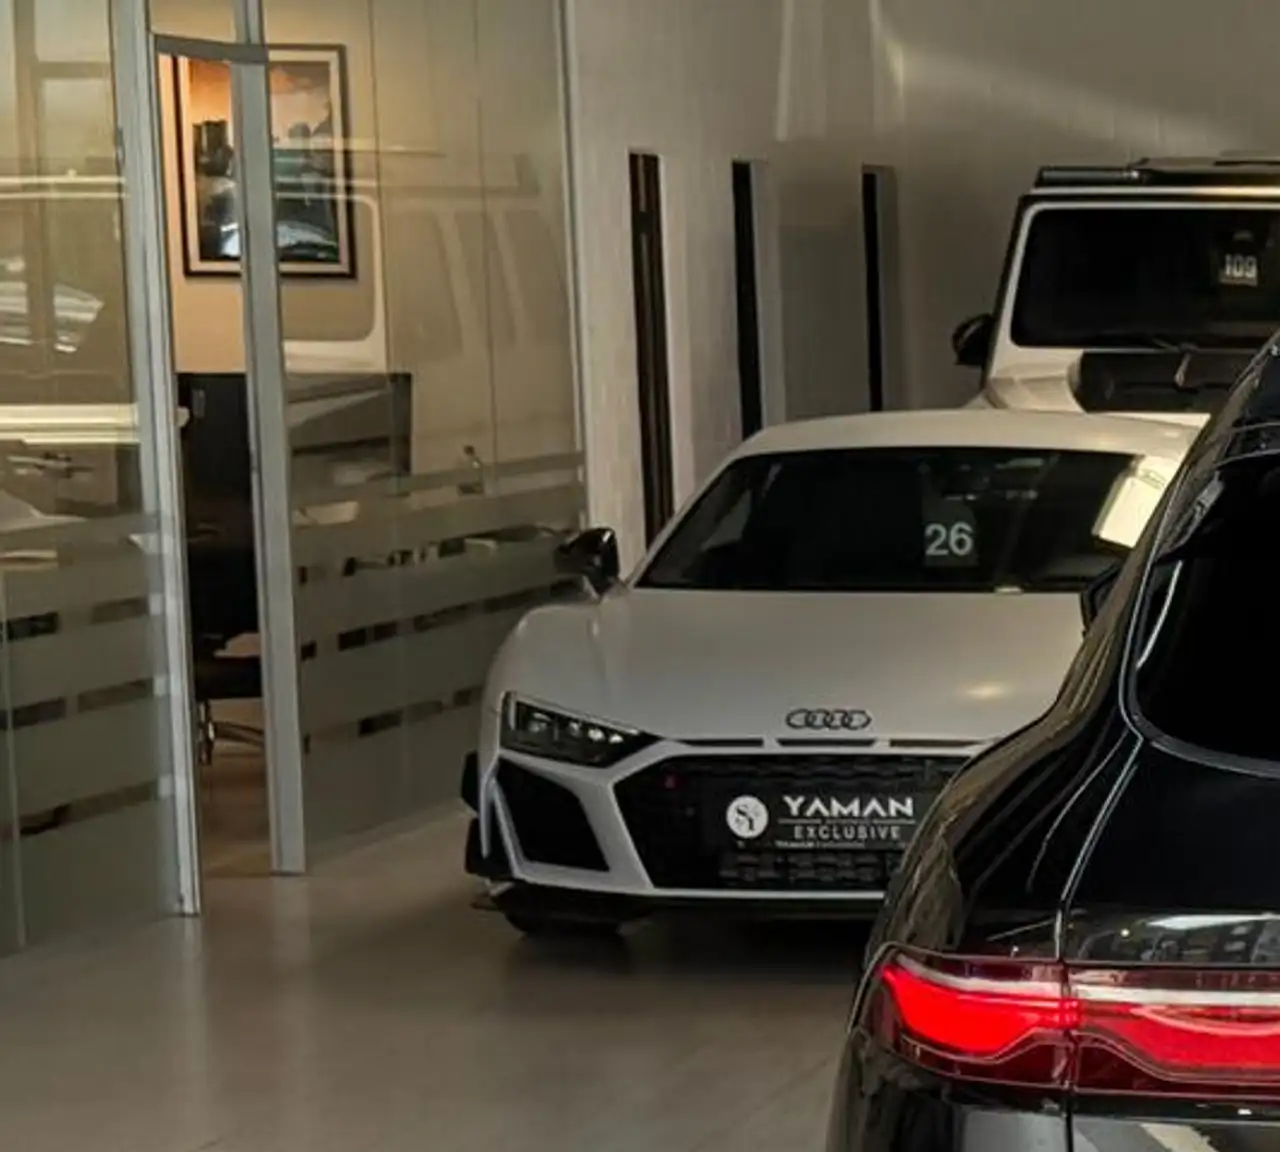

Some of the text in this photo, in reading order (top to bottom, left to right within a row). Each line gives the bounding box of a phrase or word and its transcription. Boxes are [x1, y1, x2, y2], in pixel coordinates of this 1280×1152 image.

[924, 521, 974, 557] 26
[783, 796, 914, 817] YAMAN
[794, 826, 901, 839] EXCLUSIVE
